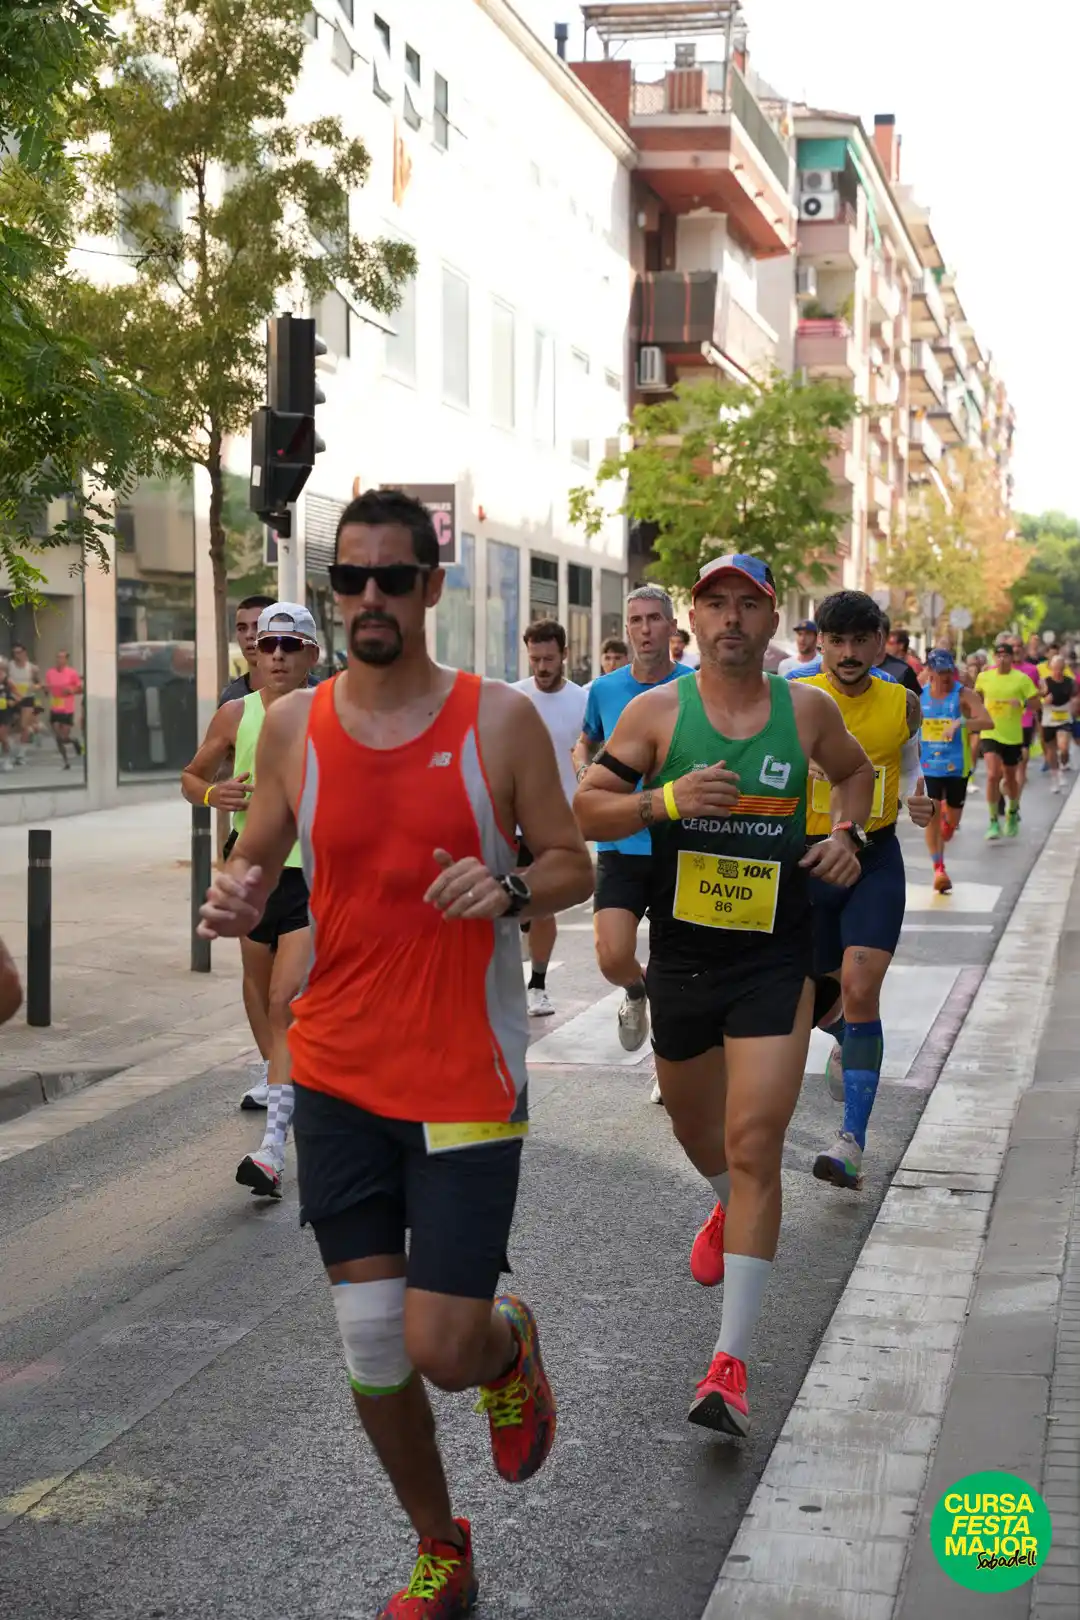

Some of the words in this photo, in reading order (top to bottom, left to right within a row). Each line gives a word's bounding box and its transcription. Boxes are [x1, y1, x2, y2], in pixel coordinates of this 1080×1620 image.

[681, 817, 784, 836] CERDANYOLA
[743, 864, 774, 880] 10K
[699, 880, 753, 901] DAVID
[714, 900, 733, 913] 86
